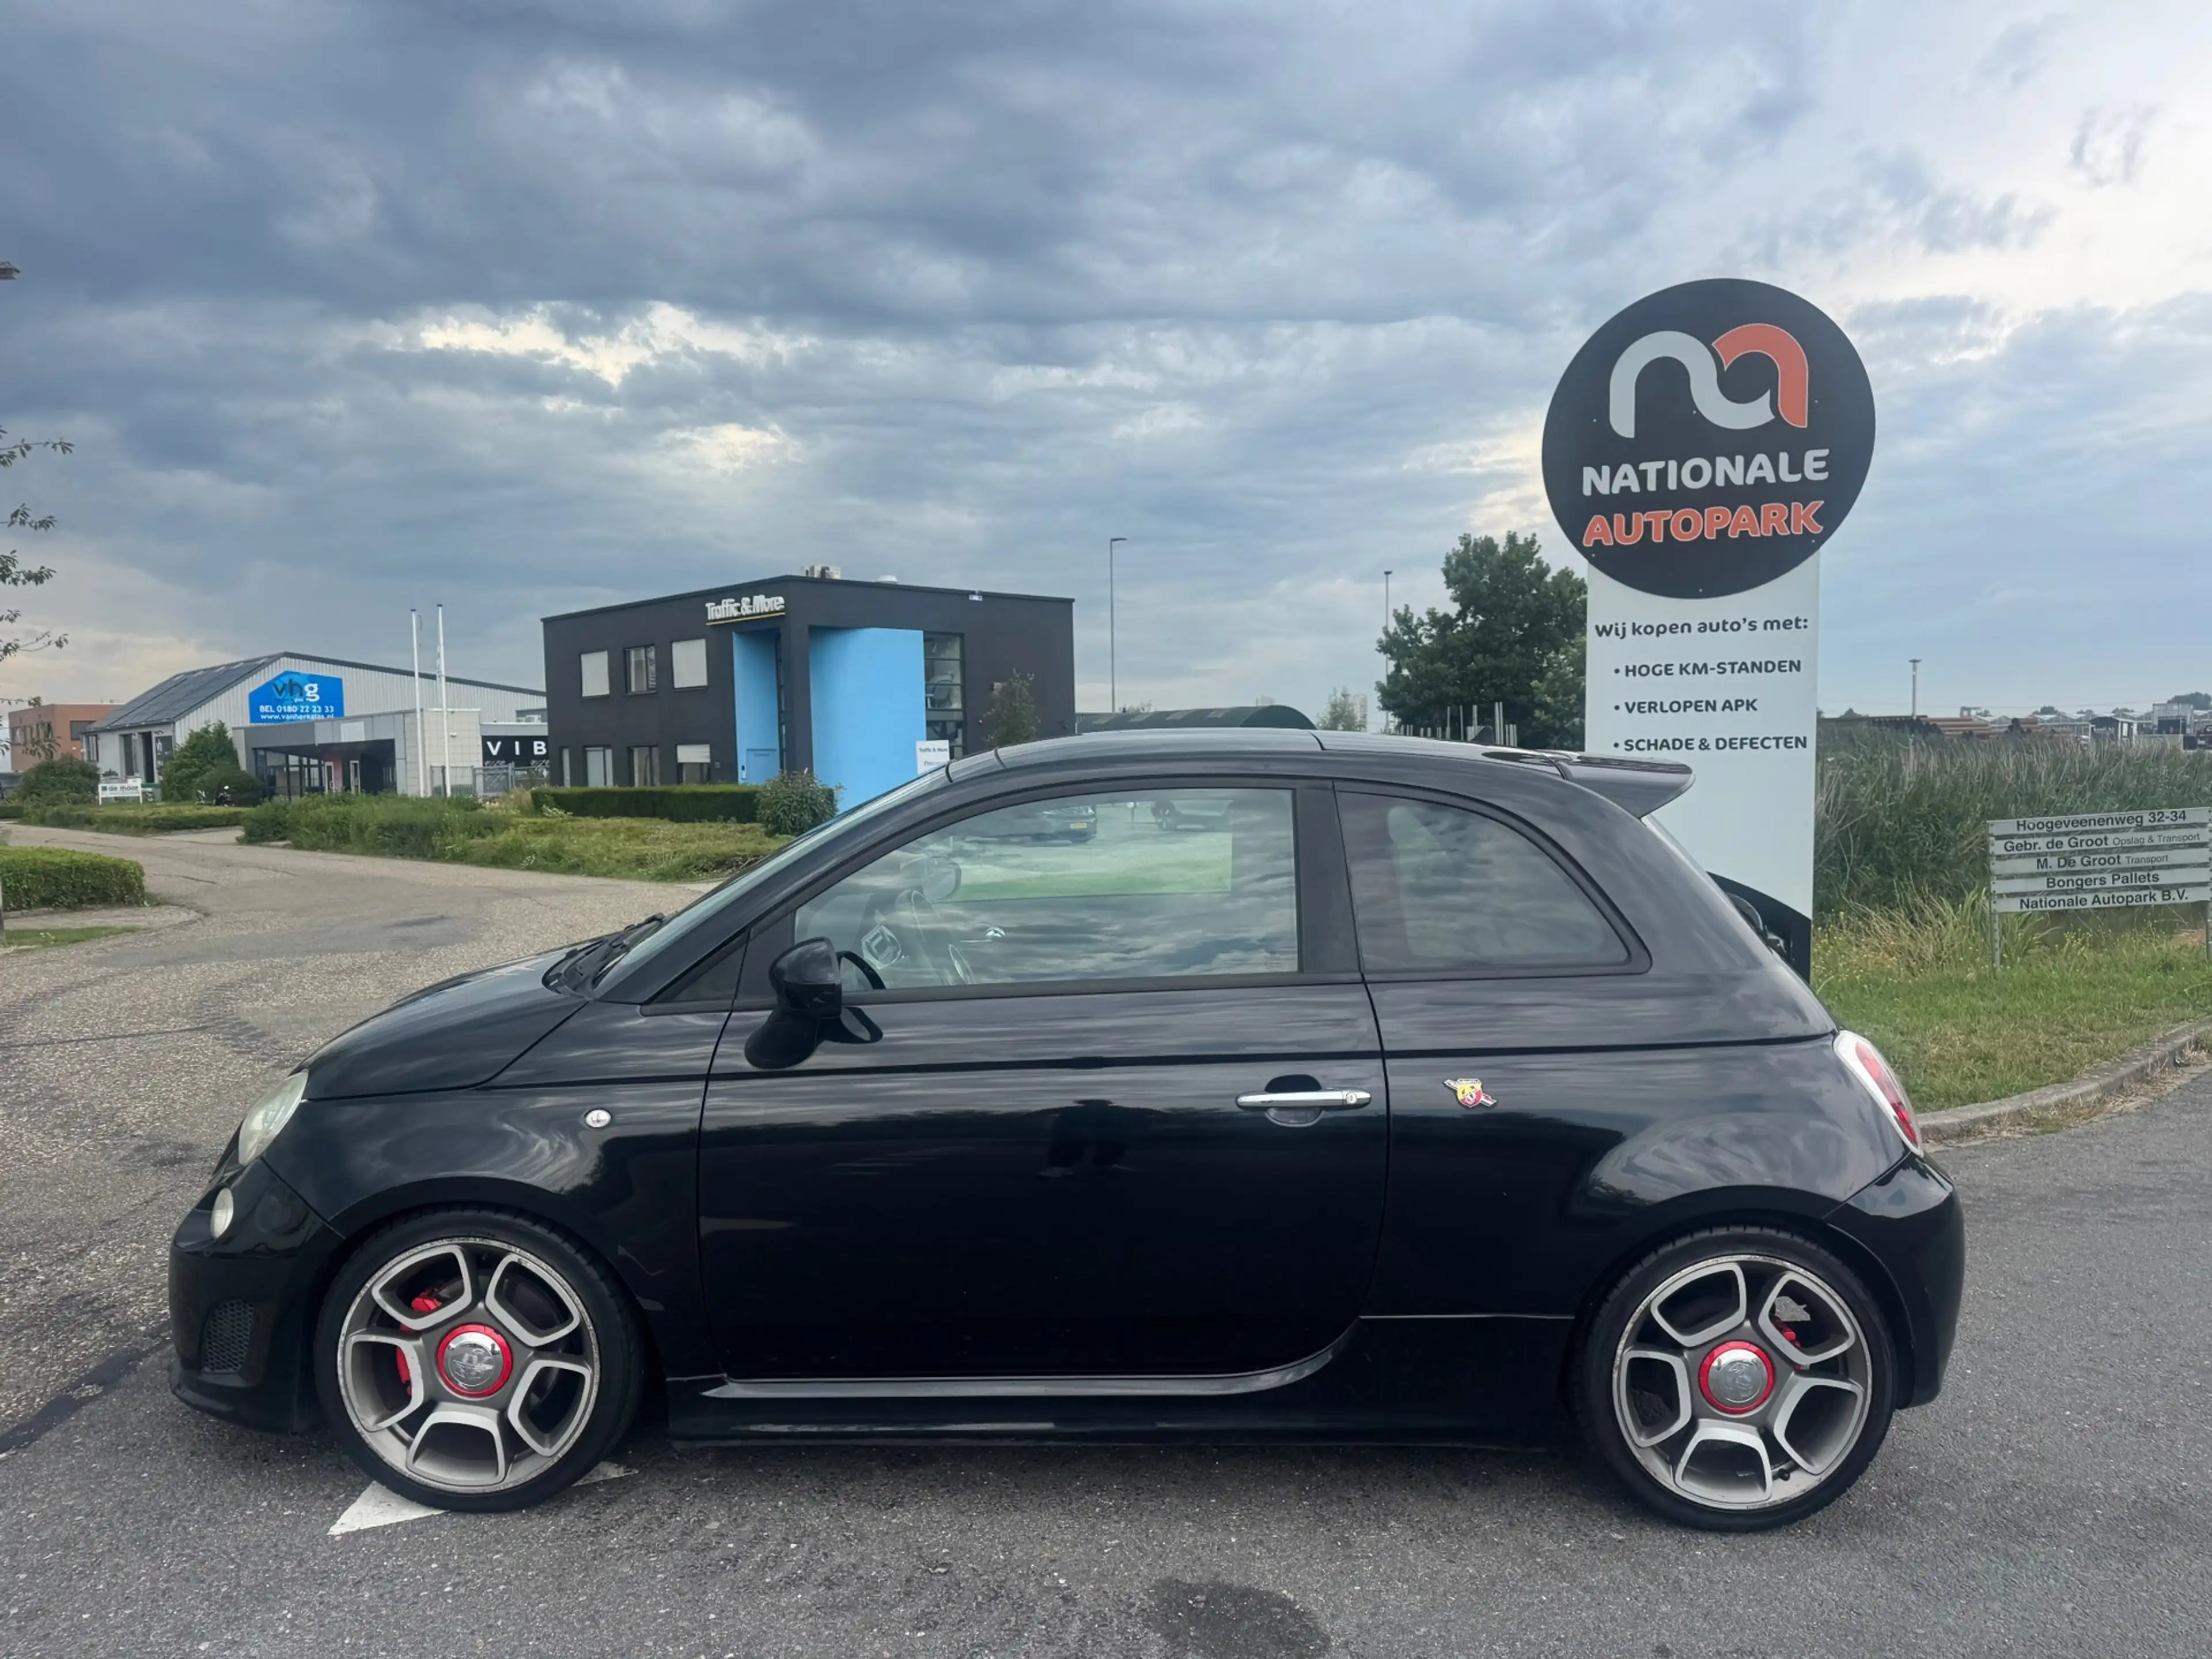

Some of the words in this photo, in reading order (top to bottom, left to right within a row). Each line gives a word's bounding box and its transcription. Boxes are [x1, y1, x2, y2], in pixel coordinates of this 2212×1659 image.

[1582, 449, 1830, 496] NATIONALE
[1582, 501, 1824, 547] AUTOPARK
[704, 598, 741, 620] Traffic
[741, 597, 752, 616] &
[753, 594, 785, 613] More
[1595, 623, 1626, 639] Wij
[1632, 622, 1692, 638] kopen
[1698, 618, 1758, 633] auto's
[1763, 616, 1808, 631] met:
[1625, 664, 1674, 677] HOGE
[1679, 660, 1801, 676] KM-STANDEN
[272, 679, 320, 702] vhg
[1625, 699, 1717, 714] VERLOPEN
[1721, 698, 1759, 712] APK
[1624, 738, 1695, 751] SCHADE
[1698, 737, 1711, 751] &
[1715, 736, 1807, 749] DEFECTEN
[2017, 814, 2143, 832] Hoogeveenenweg
[2148, 810, 2186, 823] 32-34
[2003, 840, 2041, 853] Gebr.
[2046, 838, 2063, 850] de
[2068, 835, 2109, 849] Groot
[2112, 834, 2145, 847] Opslag
[2147, 835, 2154, 843] &
[2157, 832, 2200, 843] Transport
[2037, 858, 2052, 870] M.
[2057, 856, 2075, 869] De
[2080, 855, 2121, 867] Groot
[2126, 854, 2168, 865] Transport
[2046, 874, 2107, 889] Bongers
[2112, 872, 2160, 885] Pallets
[2020, 895, 2088, 910] Nationale
[2091, 891, 2157, 907] Autopark
[2161, 889, 2188, 901] B.V.
